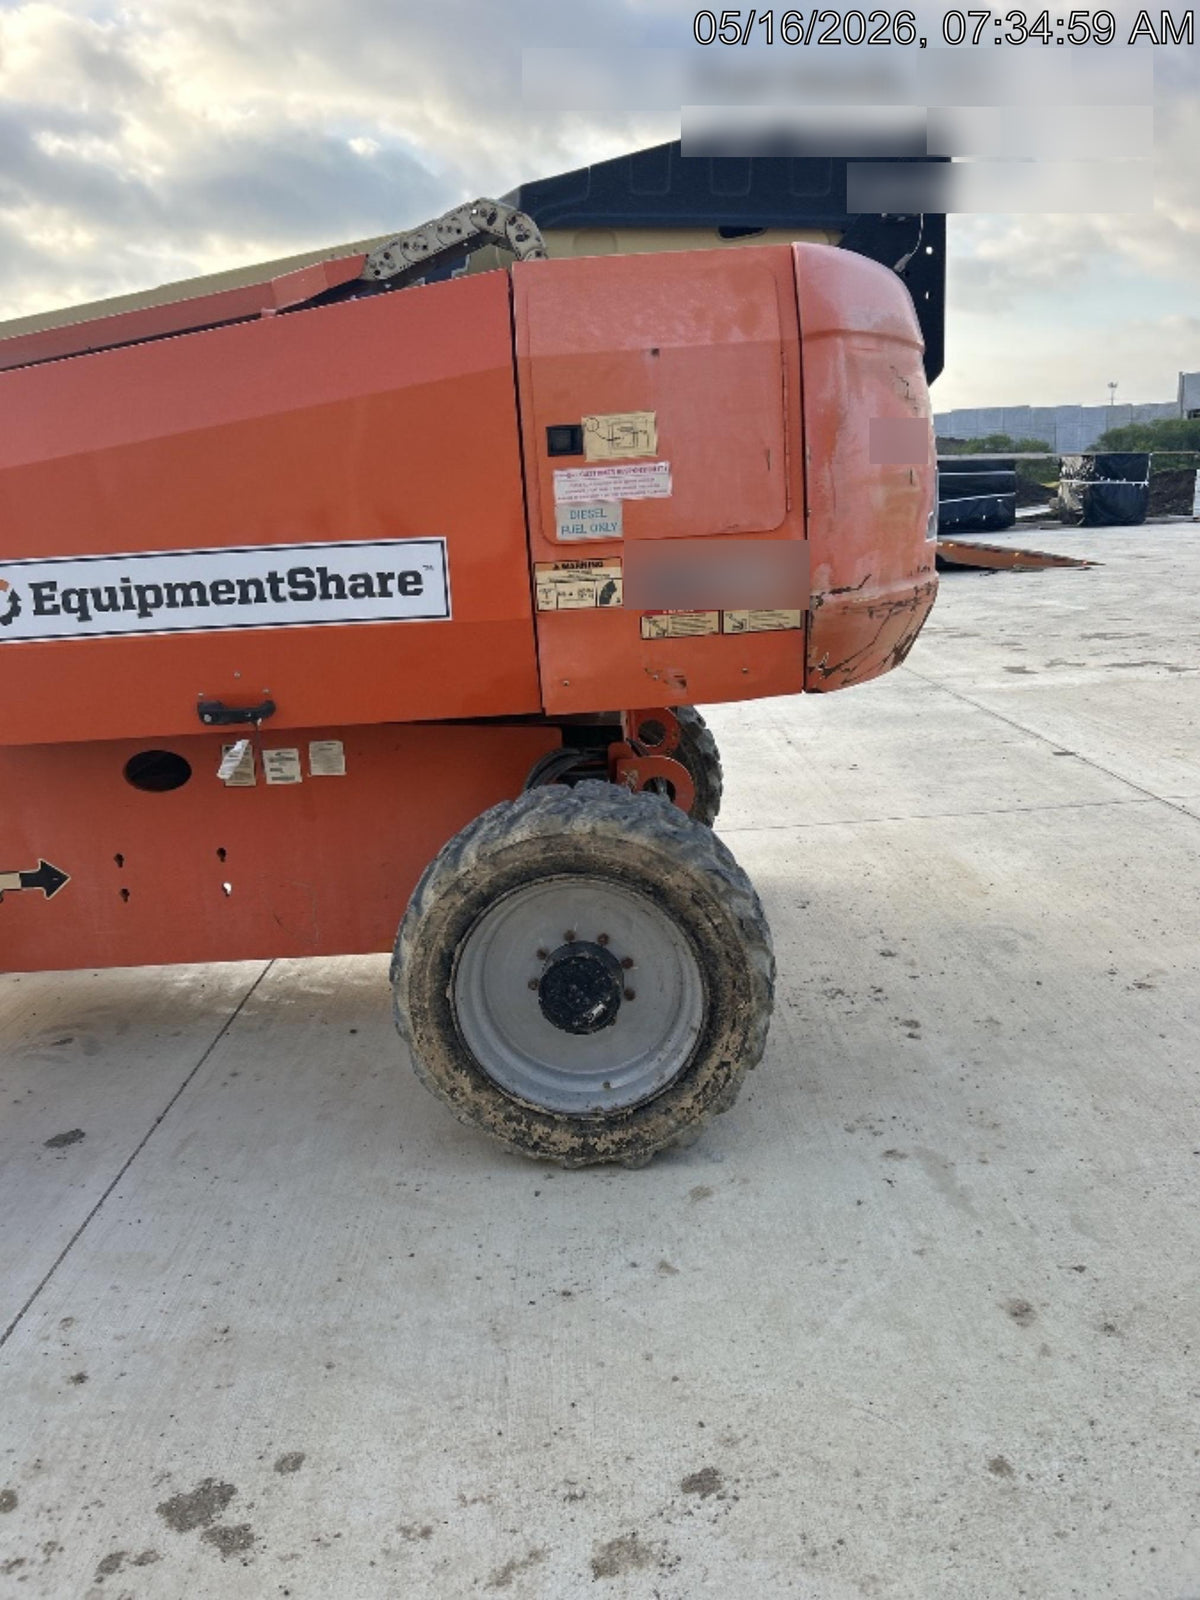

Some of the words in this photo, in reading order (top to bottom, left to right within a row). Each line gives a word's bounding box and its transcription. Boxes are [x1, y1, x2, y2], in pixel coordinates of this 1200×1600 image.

[569, 507, 607, 520] DIESEL
[561, 524, 587, 536] FUEL
[590, 522, 618, 533] ONLY
[28, 566, 424, 622] EquipmentShare
